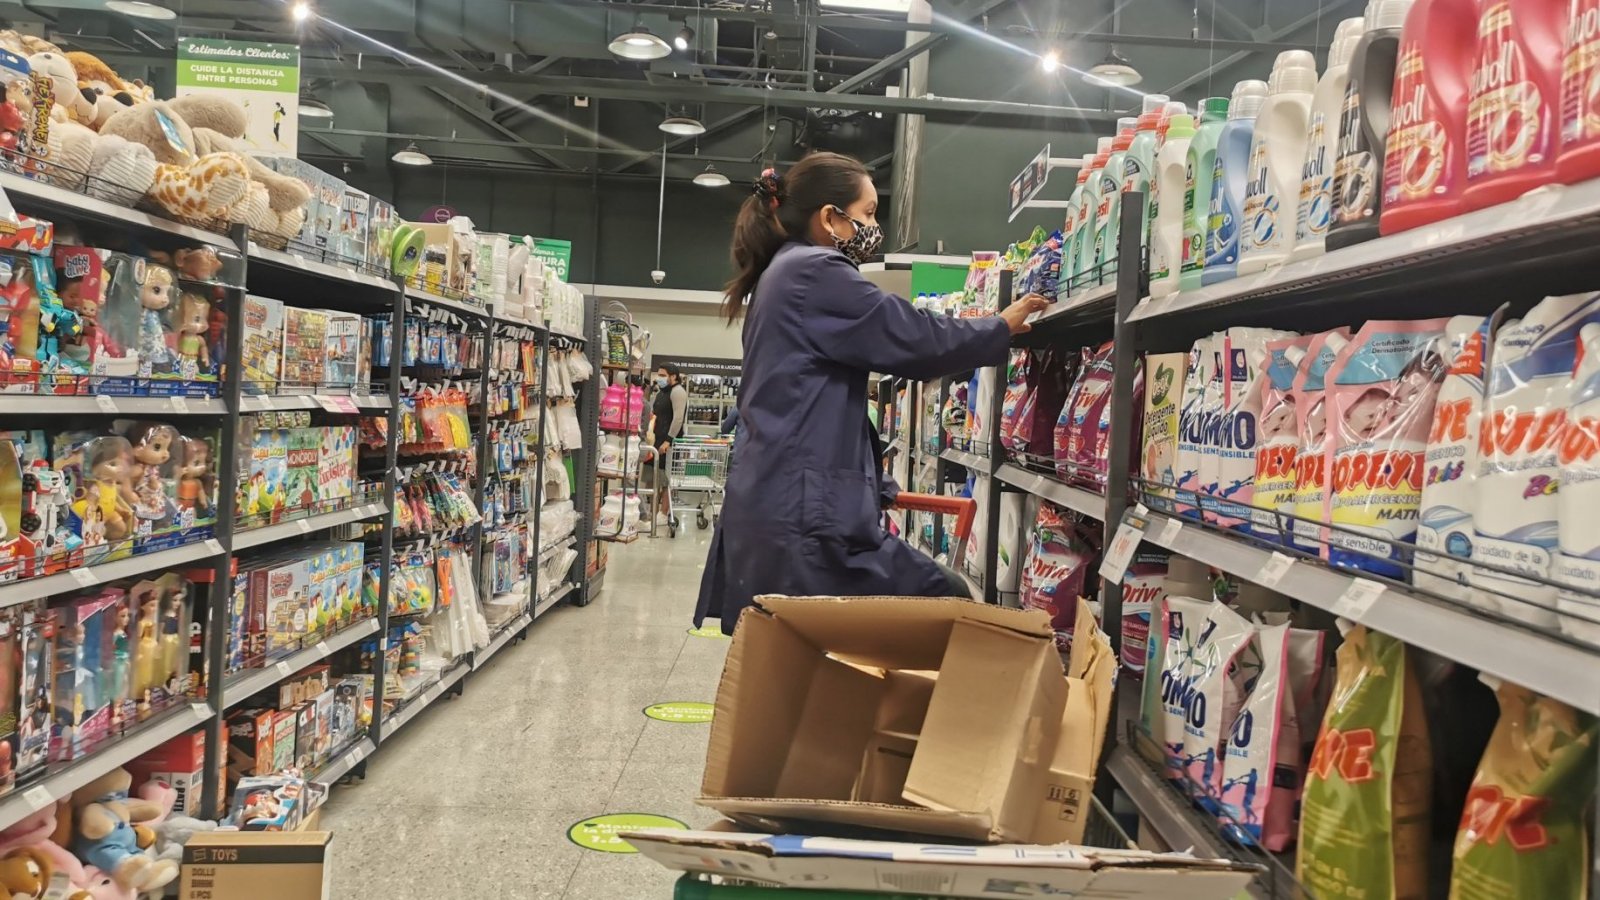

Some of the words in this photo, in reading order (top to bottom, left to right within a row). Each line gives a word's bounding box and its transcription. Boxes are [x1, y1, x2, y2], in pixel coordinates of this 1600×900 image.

[188, 44, 243, 56] Estimados
[245, 47, 291, 60] Clientes:
[190, 64, 218, 73] CUIDE
[220, 66, 233, 74] LA
[236, 67, 285, 77] DISTANCIA
[196, 74, 226, 83] ENTRE
[229, 76, 278, 86] PERSONAS
[65, 254, 90, 268] baby
[65, 264, 90, 277] alive
[1371, 338, 1410, 347] Certificado
[1144, 403, 1176, 425] Detergente
[1531, 551, 1543, 564] la
[211, 848, 238, 861] TOYS
